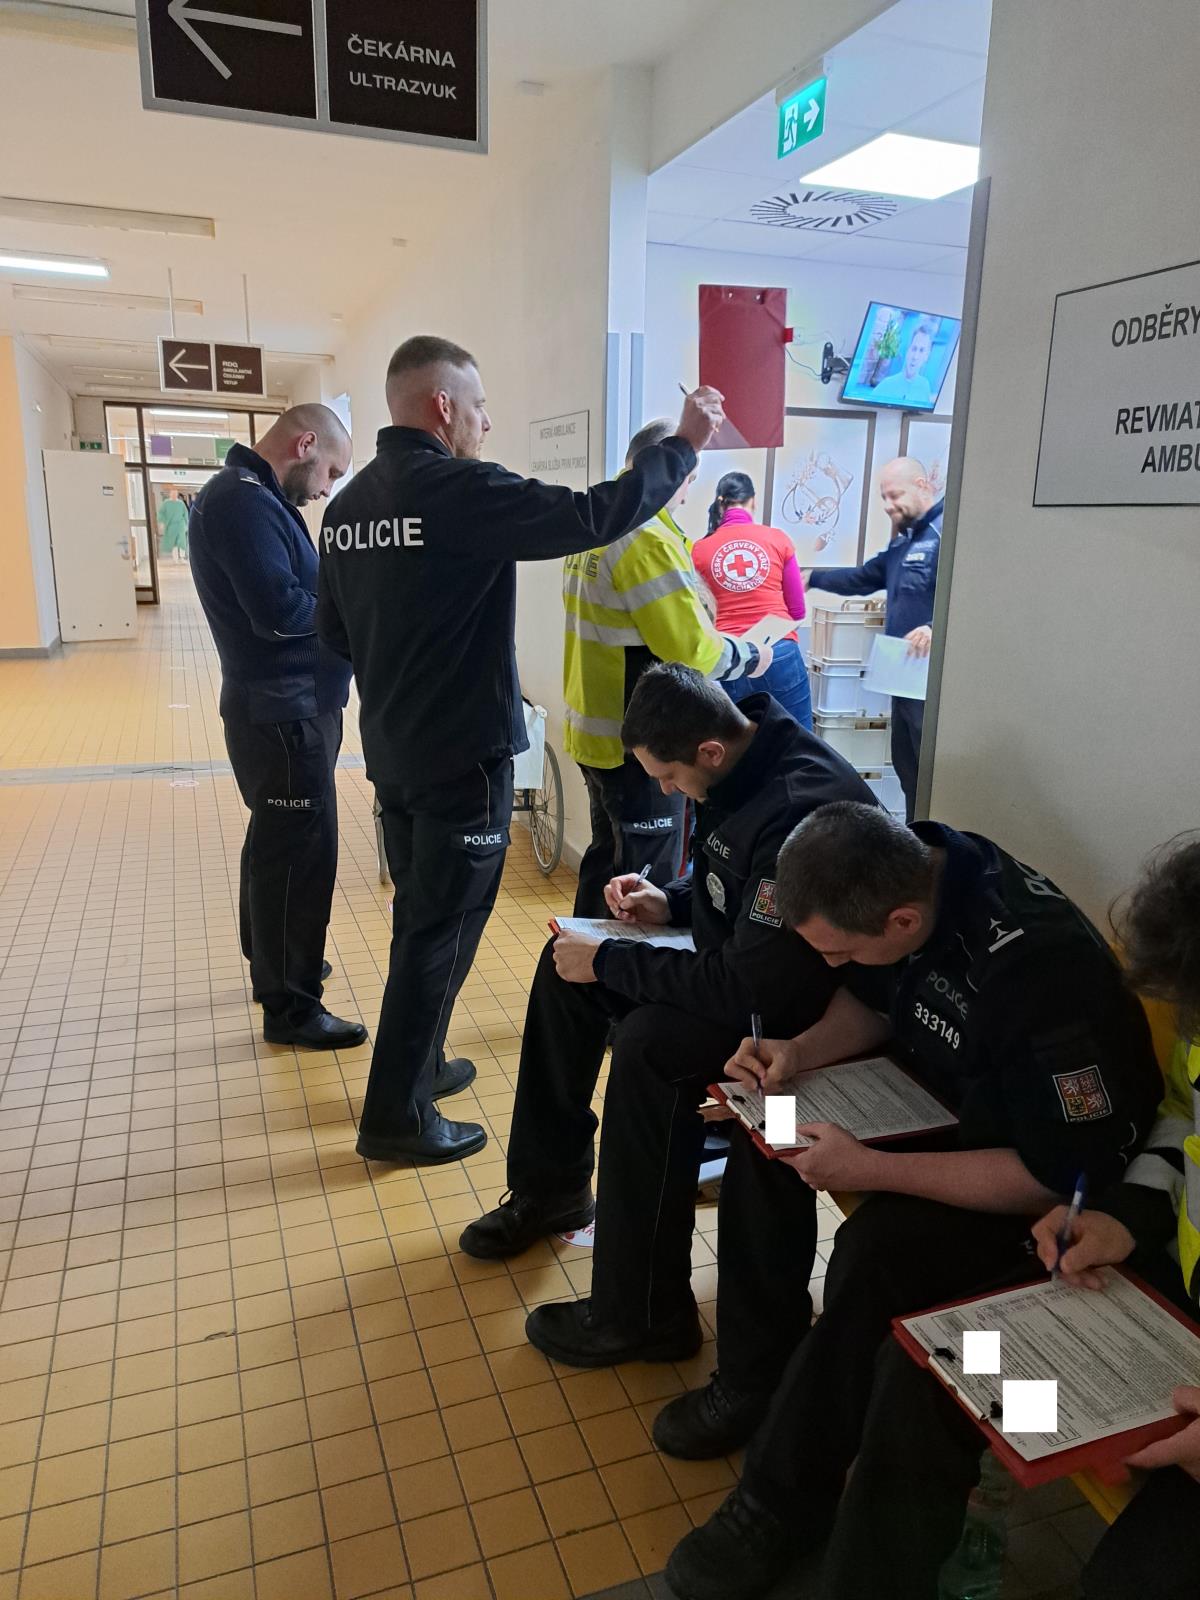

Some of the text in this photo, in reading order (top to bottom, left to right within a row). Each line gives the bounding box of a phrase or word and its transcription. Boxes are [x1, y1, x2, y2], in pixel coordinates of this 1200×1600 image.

[347, 33, 456, 68] ČEKÁRNA
[349, 71, 457, 99] ULTRAZVUK
[1111, 303, 1200, 347] ODBĚRY
[323, 517, 424, 554] POLICIE
[267, 798, 311, 808] POLICIE
[633, 818, 673, 829] POLICIE
[464, 834, 502, 845] POLICIE
[706, 832, 731, 859] LICIE
[751, 912, 779, 925] POLICIE
[914, 1002, 960, 1049] 333149
